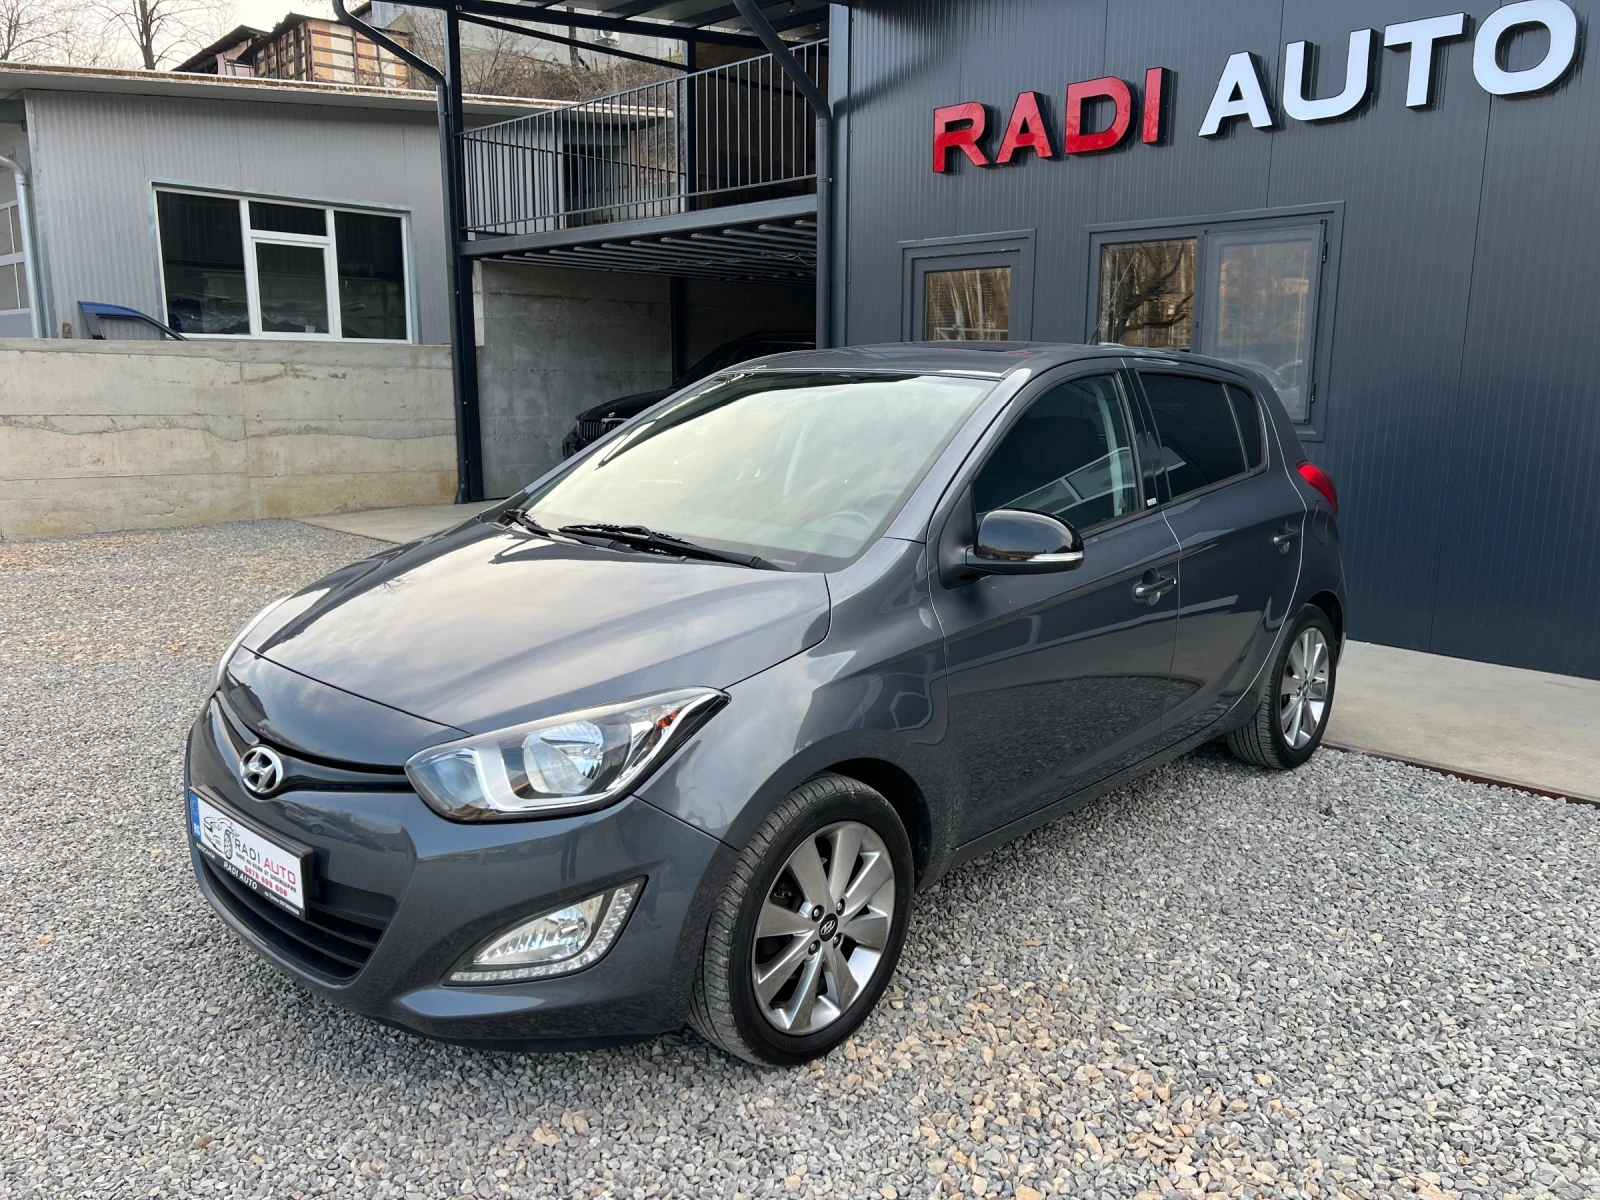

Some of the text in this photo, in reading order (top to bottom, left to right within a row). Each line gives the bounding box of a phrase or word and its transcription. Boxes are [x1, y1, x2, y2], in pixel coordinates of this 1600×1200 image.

[932, 0, 1577, 173] RADI AUTO
[223, 861, 258, 890] RADI AUTO
[235, 838, 296, 885] RADI AUTO
